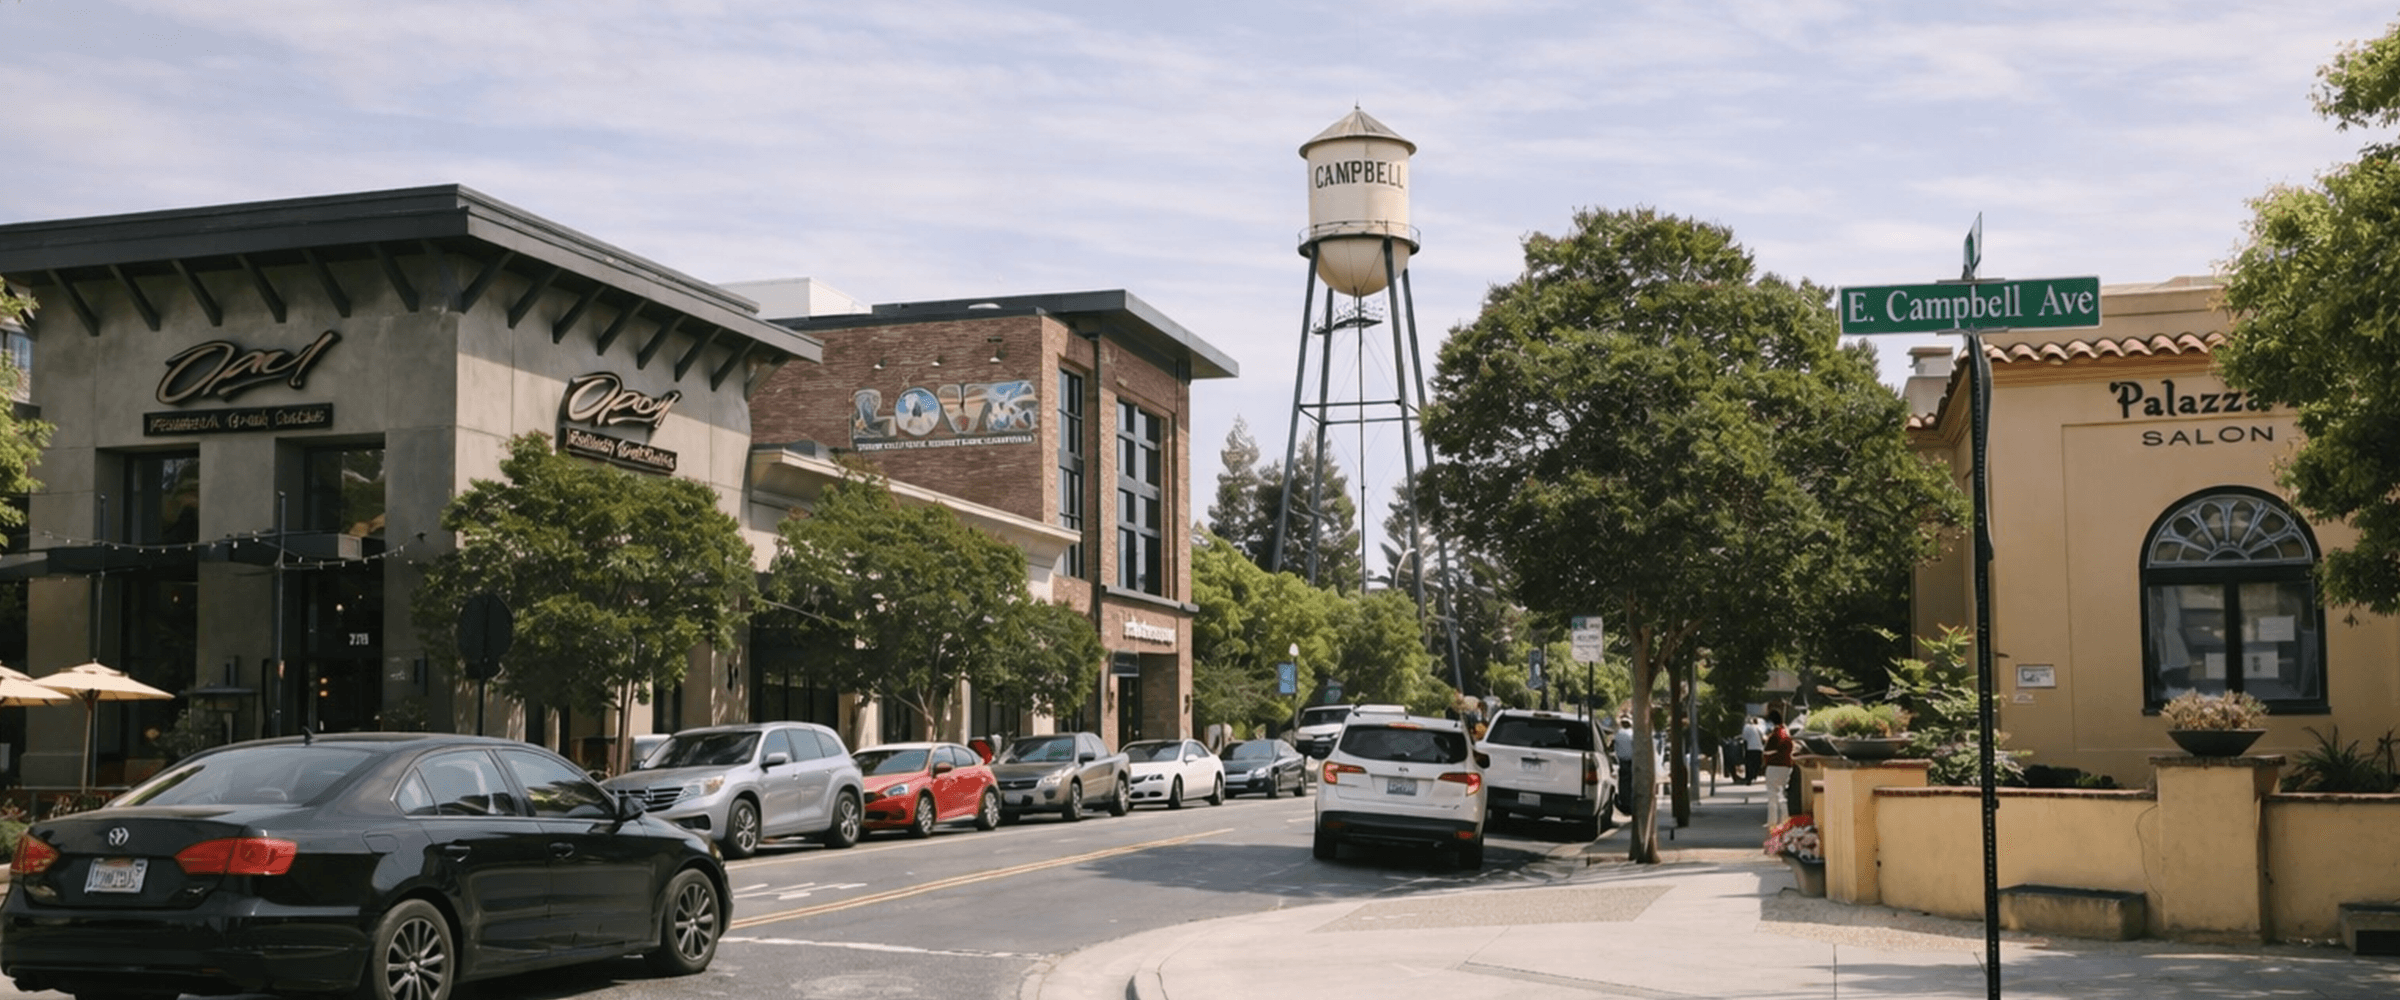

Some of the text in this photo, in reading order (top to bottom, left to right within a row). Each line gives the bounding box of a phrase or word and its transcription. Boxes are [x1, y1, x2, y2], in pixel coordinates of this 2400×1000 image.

[1315, 160, 1404, 189] CAMPBELL
[1848, 284, 2095, 330] E. Campbell Ave
[853, 380, 1039, 439] LOVE
[2142, 426, 2274, 446] SALON
